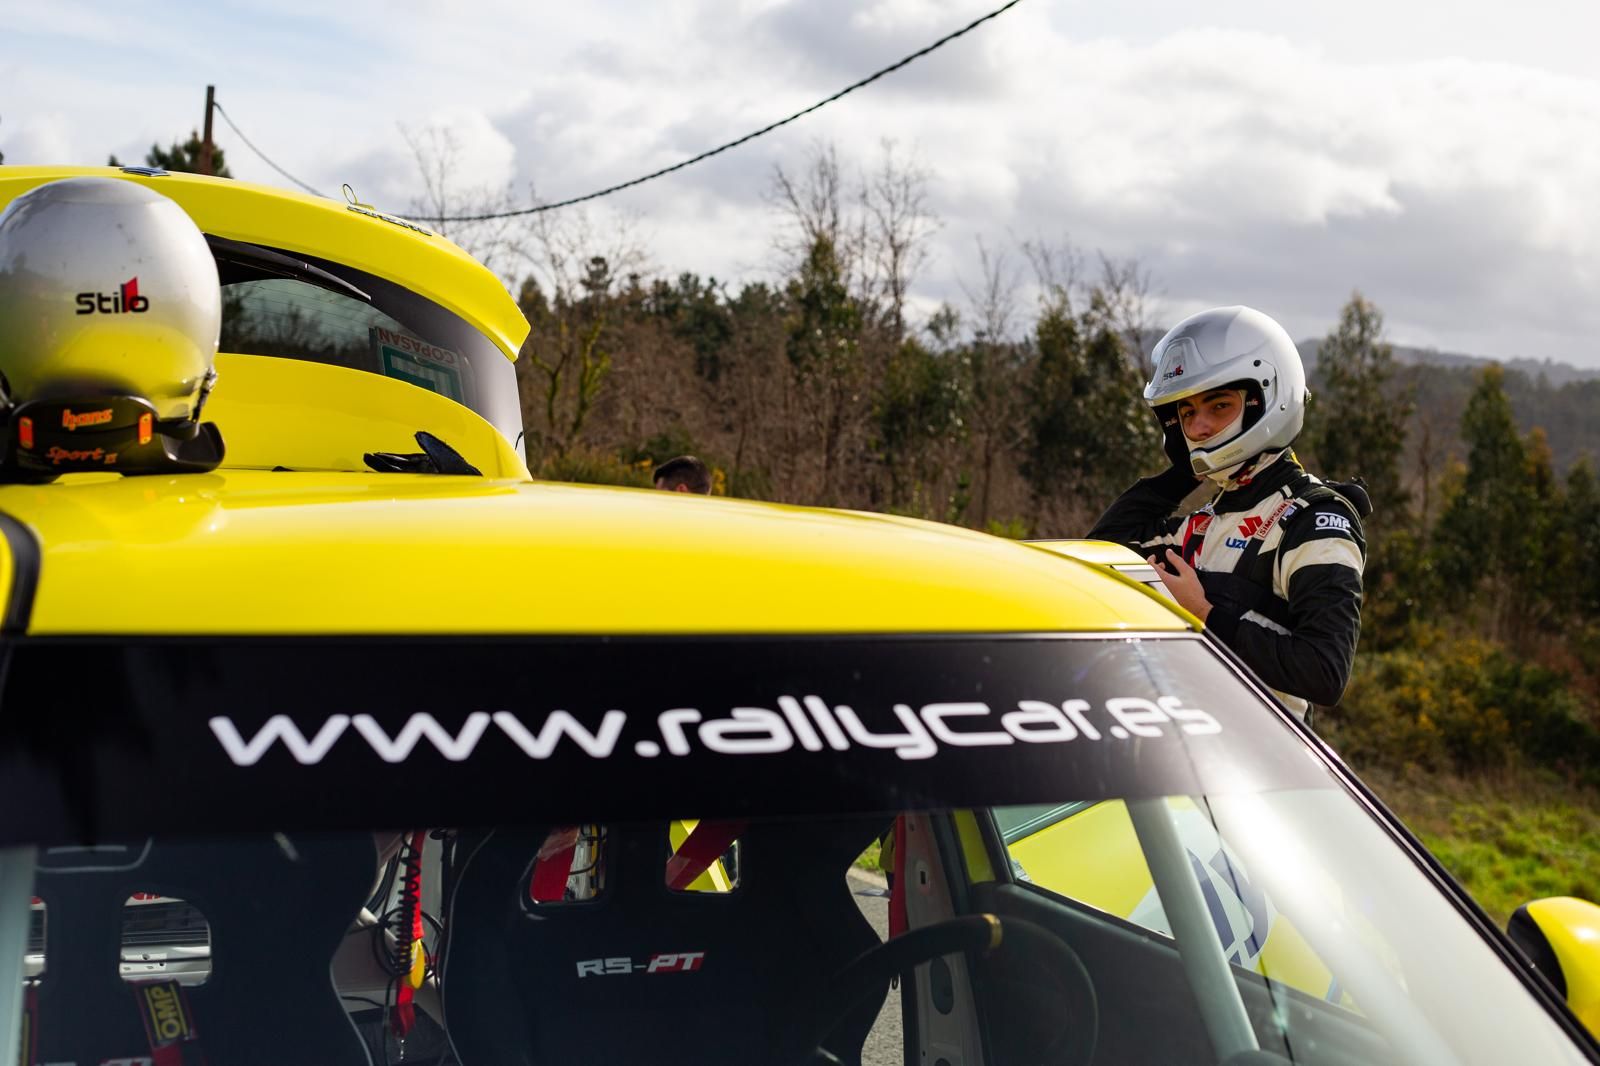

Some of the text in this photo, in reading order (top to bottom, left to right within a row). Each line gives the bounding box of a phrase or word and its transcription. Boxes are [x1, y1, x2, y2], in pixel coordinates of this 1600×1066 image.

[75, 276, 149, 315] Stilo
[378, 328, 456, 364] COPASAN
[1315, 514, 1351, 529] OMP
[209, 694, 1222, 761] www.rallycar.es
[576, 952, 704, 978] RS-PT
[151, 985, 182, 1039] OMP
